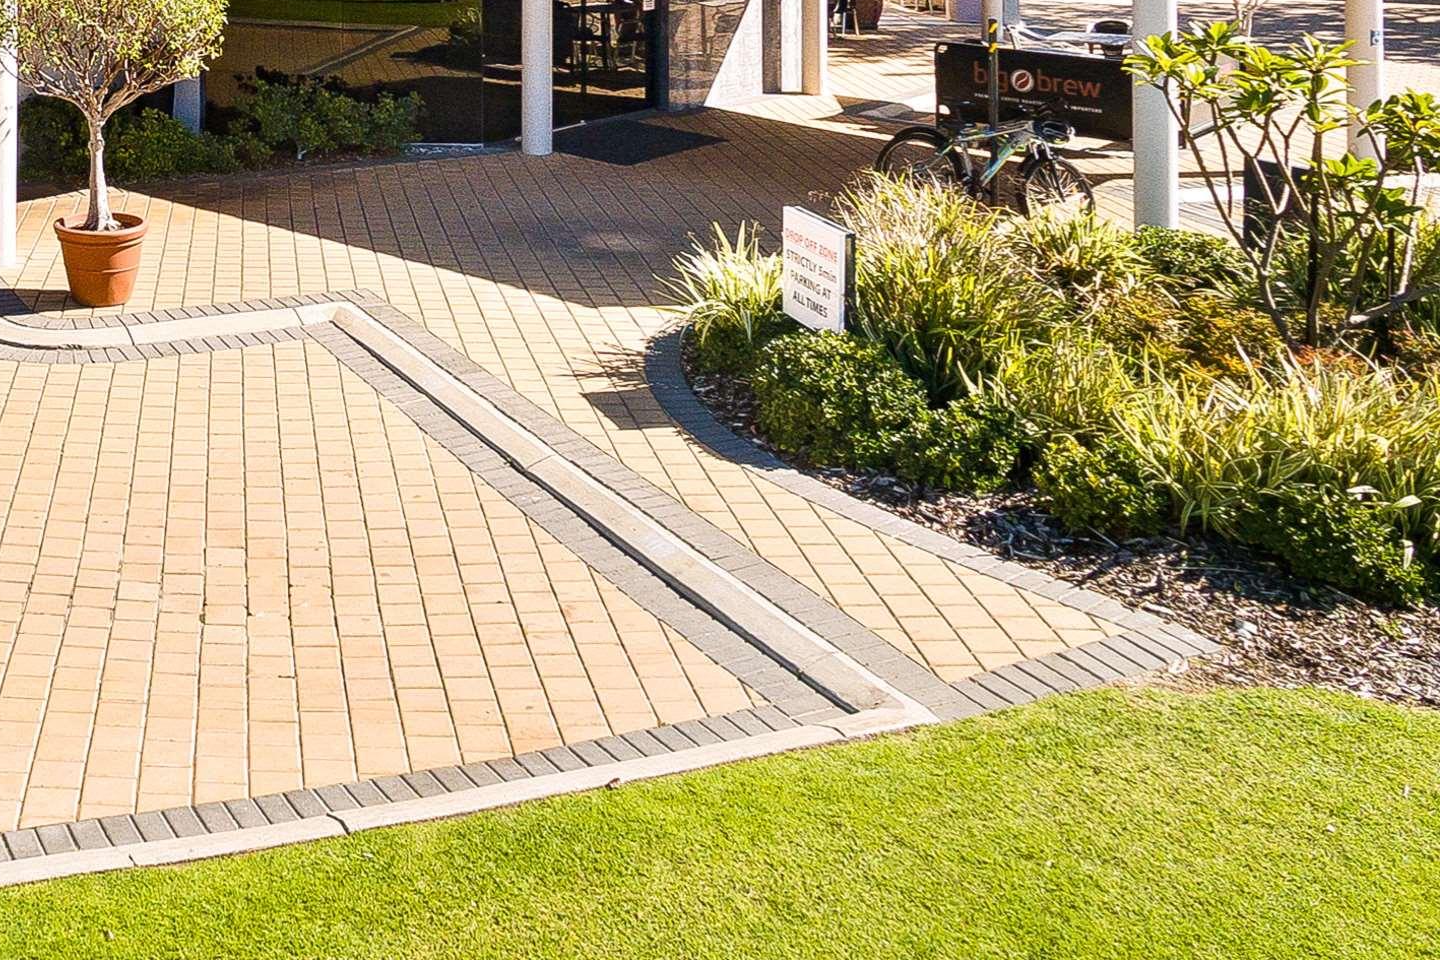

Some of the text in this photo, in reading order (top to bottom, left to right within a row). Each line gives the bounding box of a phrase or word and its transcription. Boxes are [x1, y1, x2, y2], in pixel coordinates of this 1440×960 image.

[973, 60, 1103, 98] bg brew
[786, 249, 817, 272] STRICTLY
[804, 237, 817, 251] OFF
[818, 244, 838, 263] ZONE
[790, 270, 831, 300] PARKING AT
[792, 290, 828, 318] ALL TIMES
